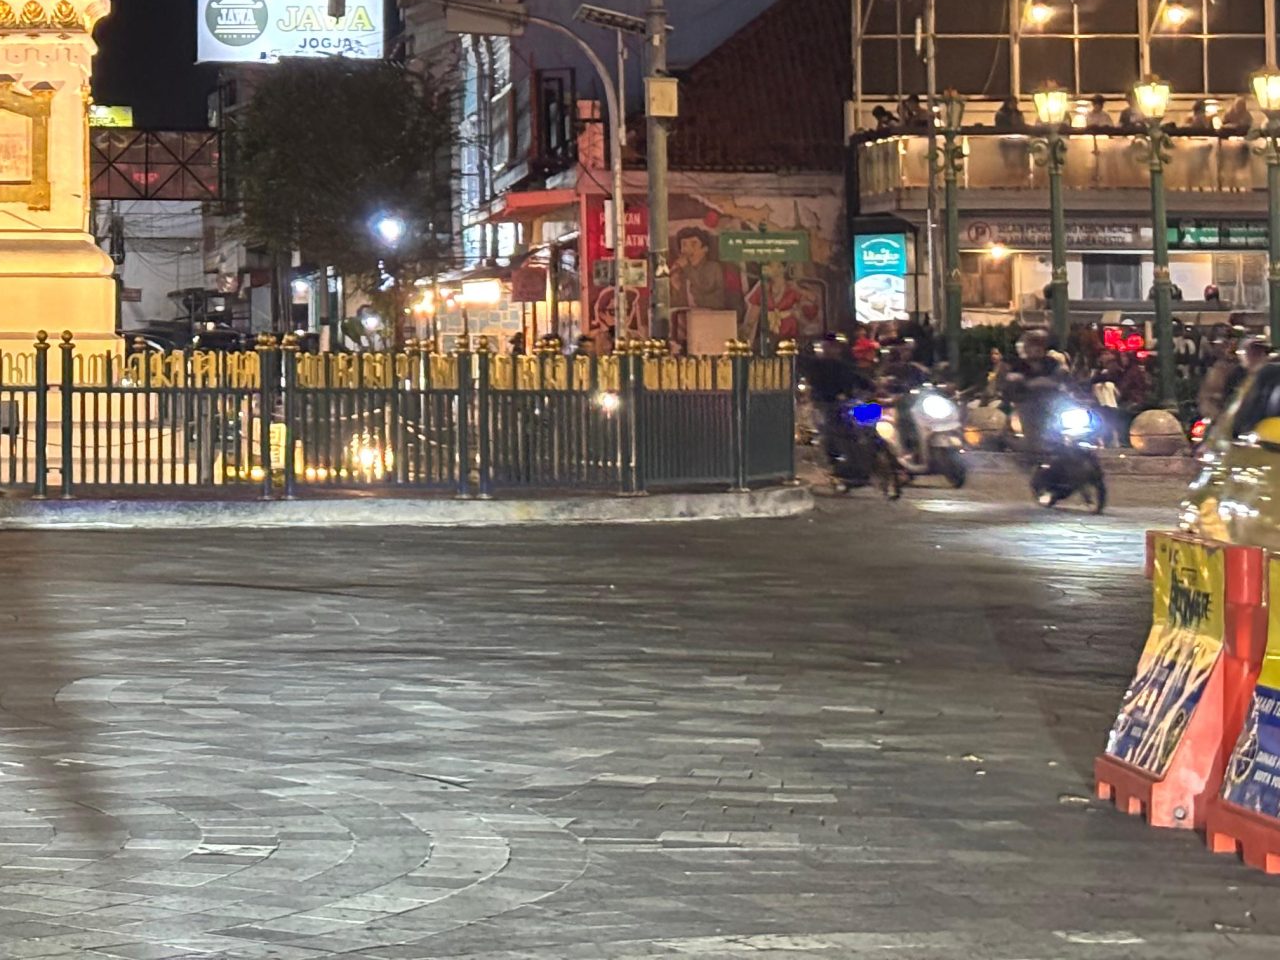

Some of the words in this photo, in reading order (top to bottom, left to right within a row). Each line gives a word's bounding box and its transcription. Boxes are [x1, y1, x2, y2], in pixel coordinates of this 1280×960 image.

[217, 8, 256, 25] JAWA
[276, 6, 375, 31] JAWA
[298, 37, 353, 49] JOGJA
